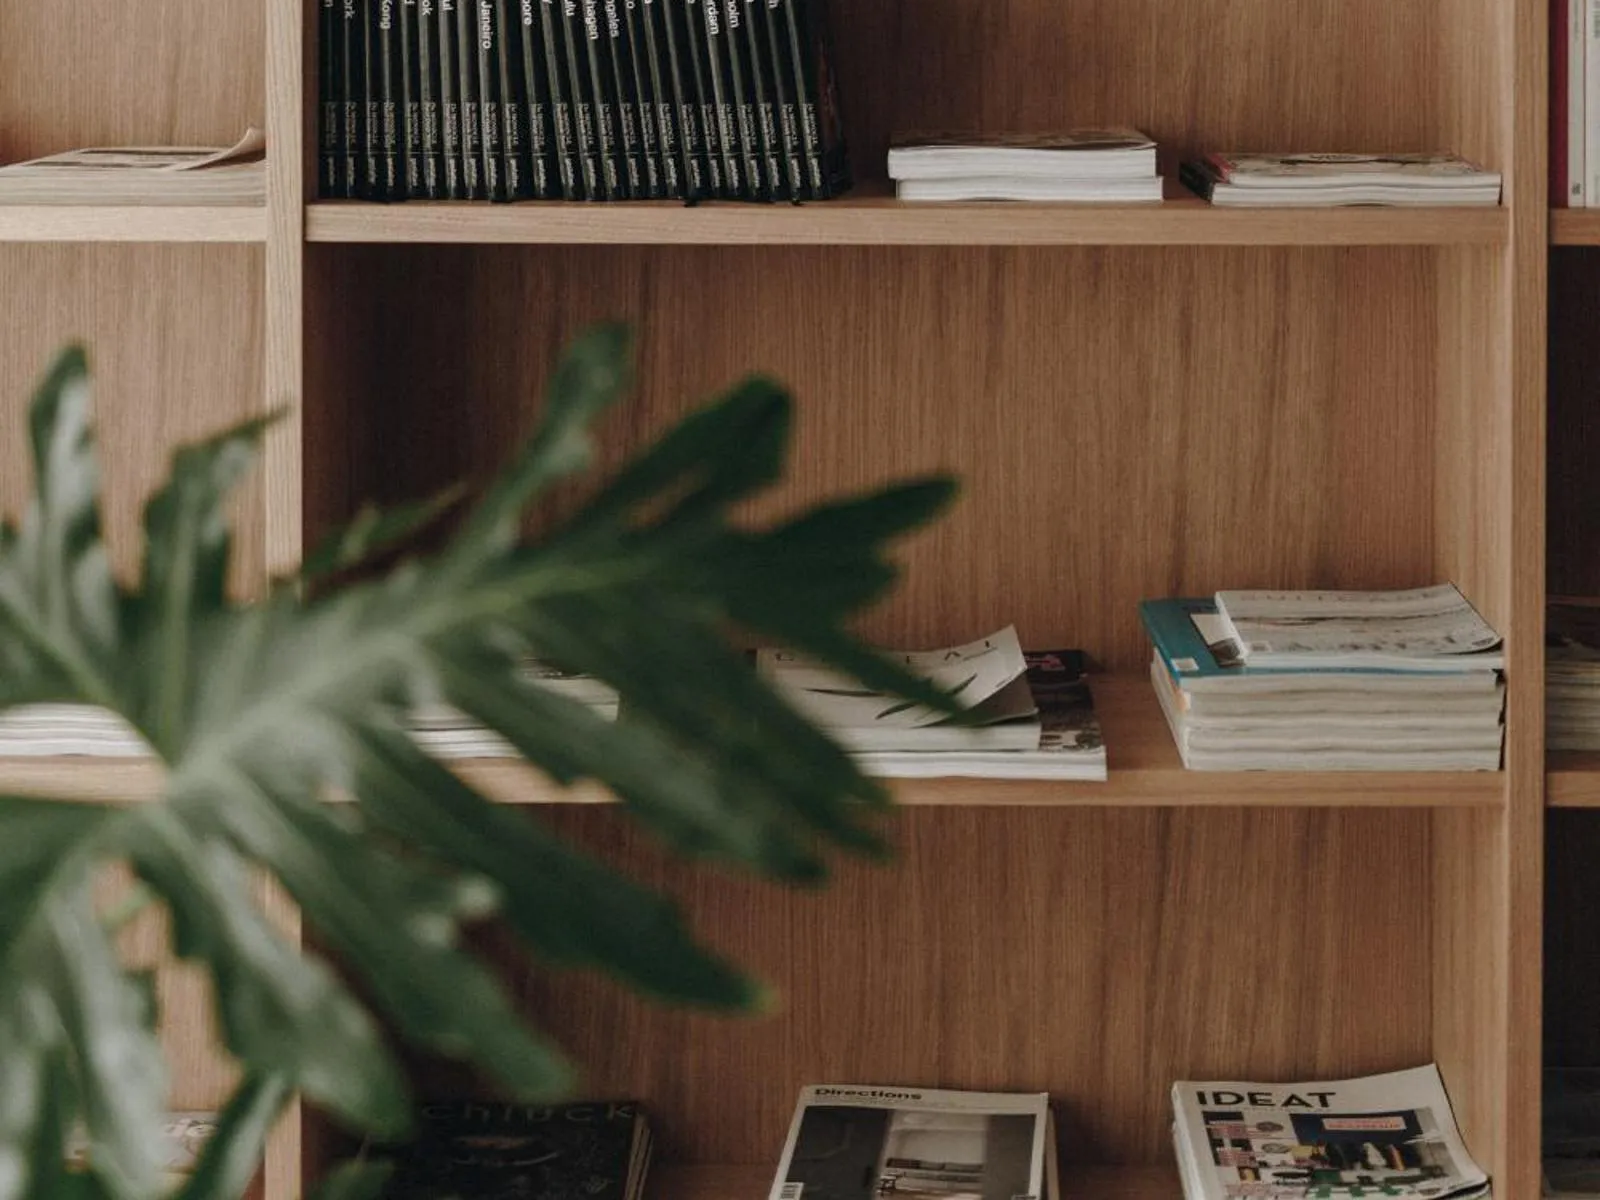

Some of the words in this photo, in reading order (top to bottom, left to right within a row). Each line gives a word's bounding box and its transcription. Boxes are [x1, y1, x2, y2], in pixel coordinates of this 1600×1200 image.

[480, 0, 492, 49] Janeiro
[813, 1088, 922, 1100] Directions
[1196, 1091, 1337, 1108] IDEAT
